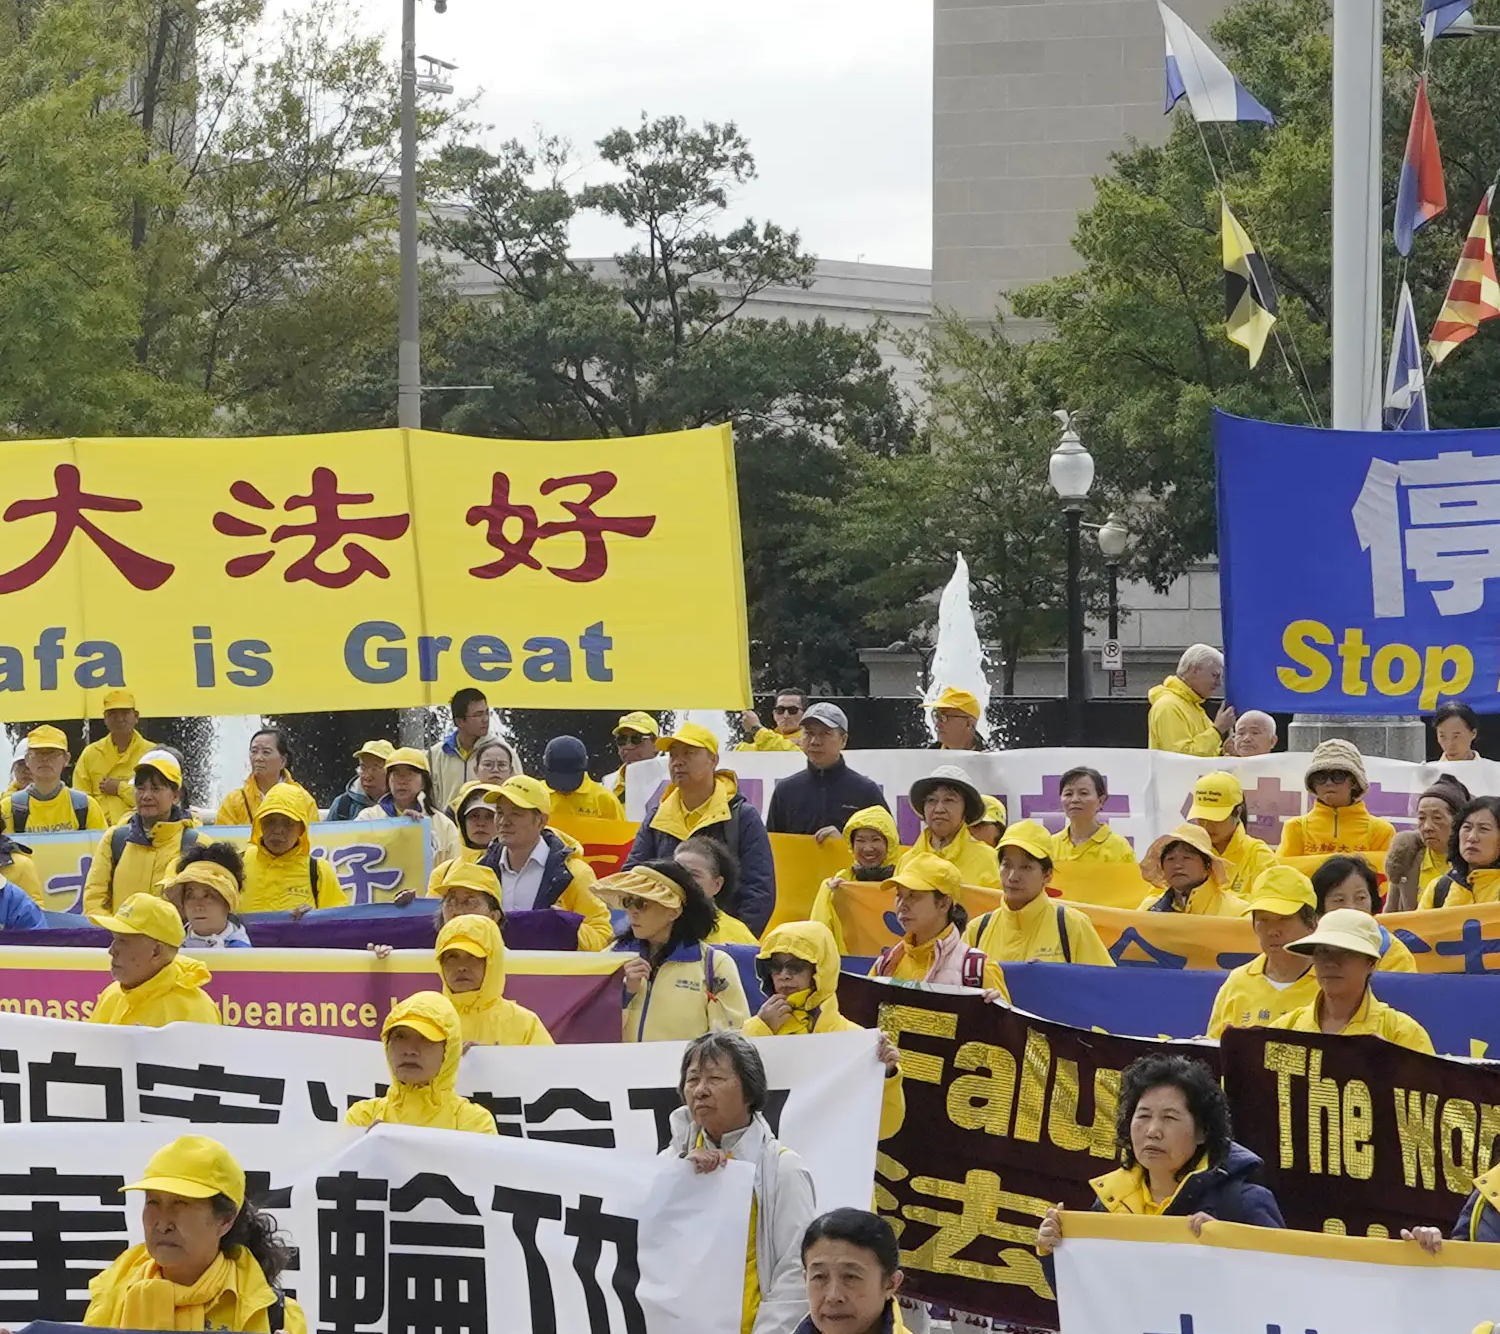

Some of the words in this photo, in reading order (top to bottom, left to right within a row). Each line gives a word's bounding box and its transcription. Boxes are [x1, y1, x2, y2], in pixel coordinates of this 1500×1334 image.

[194, 627, 272, 687] is
[345, 620, 614, 683] Great
[1277, 619, 1475, 711] Stop
[218, 1000, 377, 1030] bearance
[877, 1002, 1122, 1161] Falu
[1263, 1041, 1375, 1181] The
